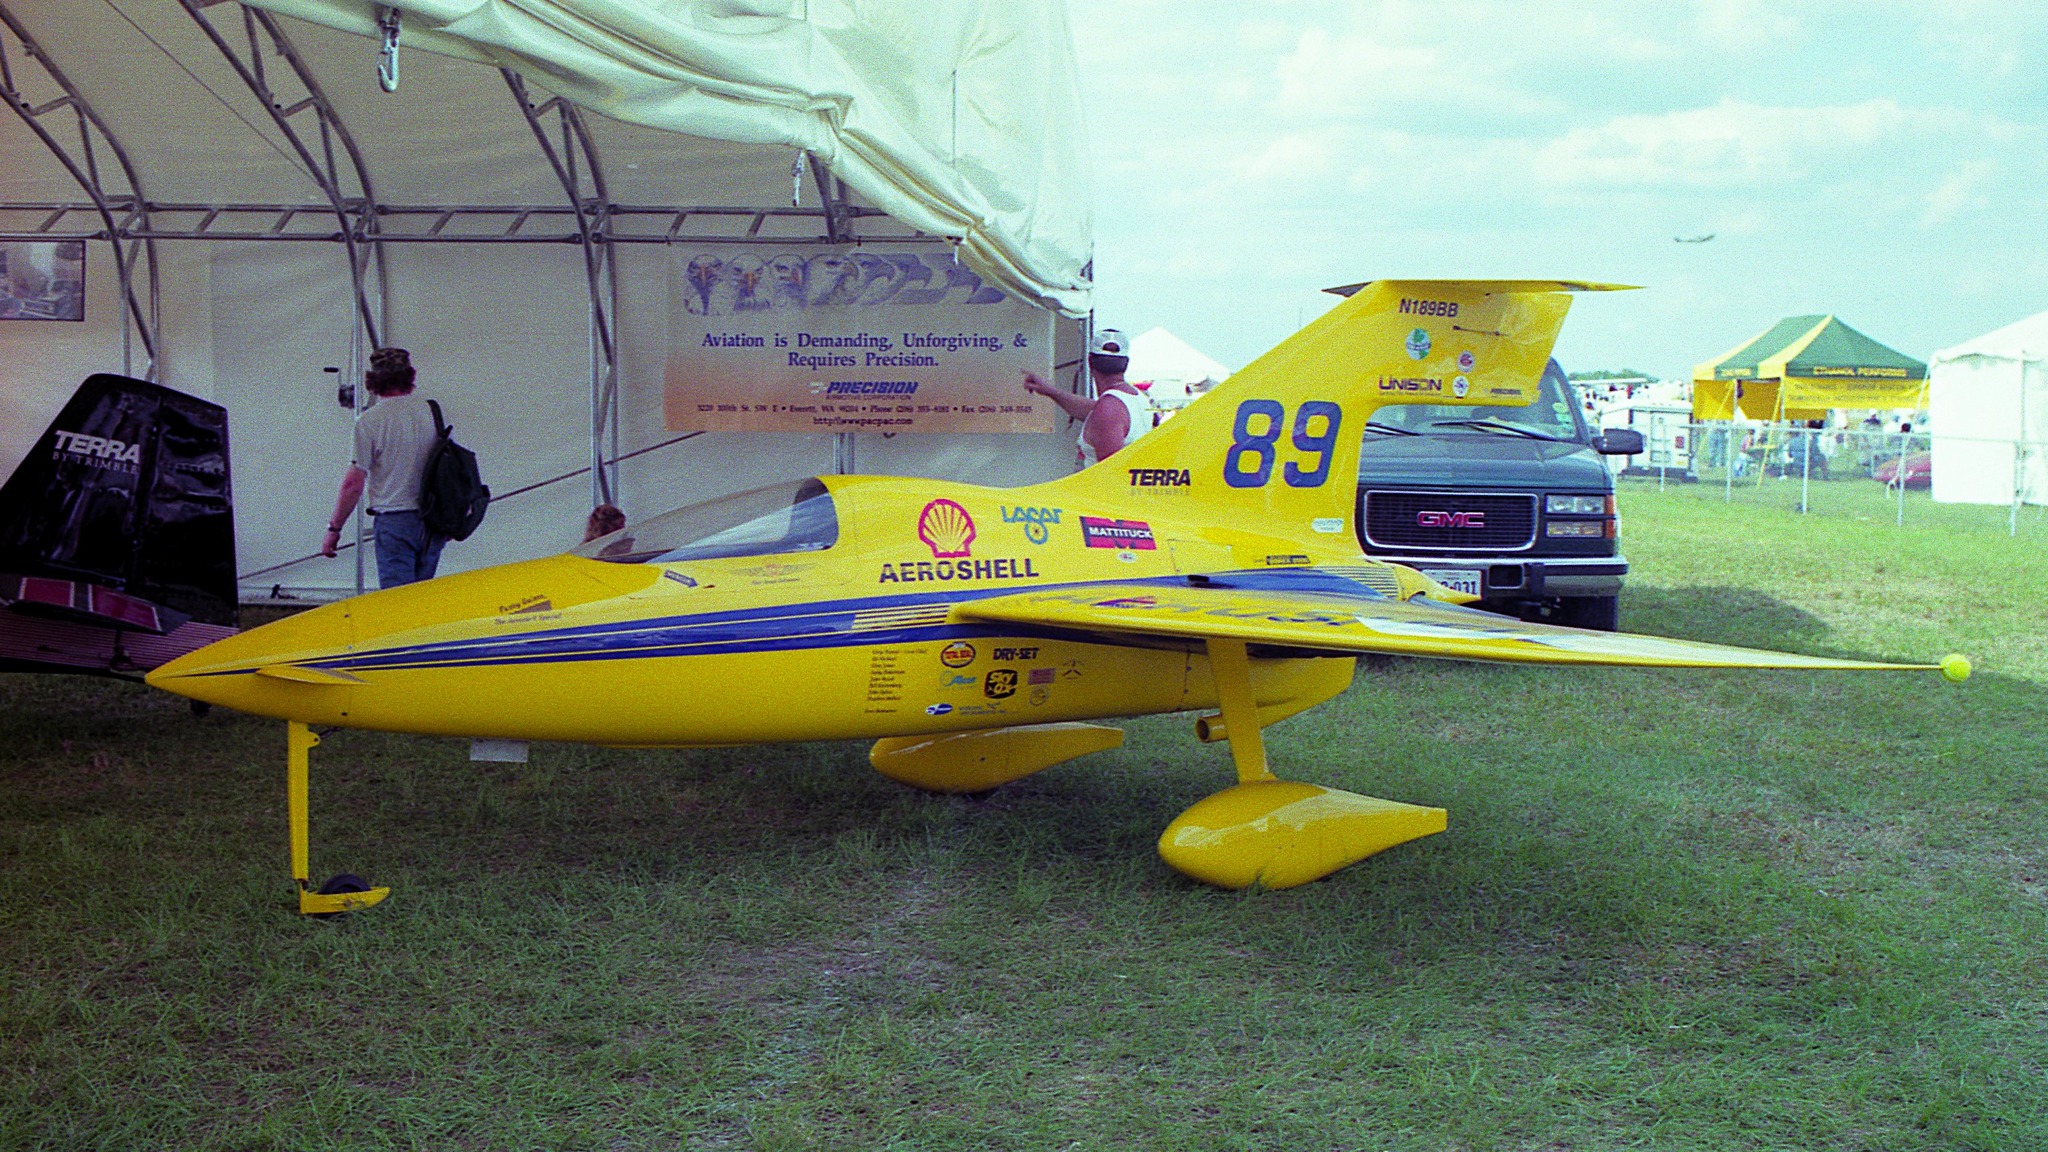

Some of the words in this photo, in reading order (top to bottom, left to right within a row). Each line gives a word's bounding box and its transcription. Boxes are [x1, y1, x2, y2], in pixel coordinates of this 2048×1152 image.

[1398, 298, 1459, 317] N189BB
[702, 333, 765, 348] Aviation
[774, 333, 788, 348] is
[797, 332, 894, 352] Demanding,
[903, 332, 1004, 352] Unforgiving,
[1013, 333, 1028, 348] &
[788, 351, 857, 371] Requires
[865, 352, 939, 367] Precision.
[826, 381, 919, 394] PRECISION
[1378, 375, 1442, 391] UNISON
[869, 404, 893, 413] Phone
[961, 405, 975, 413] Fax
[55, 429, 140, 464] TERRA
[1222, 399, 1343, 489] 89
[52, 451, 68, 461] BY
[76, 455, 138, 475] TRIMBLE
[1128, 468, 1192, 487] TERRA
[1416, 510, 1485, 528] GMC
[1088, 526, 1153, 539] MATTITUCK
[879, 558, 1040, 583] AEROSHELL
[993, 647, 1040, 661] DRY-SET
